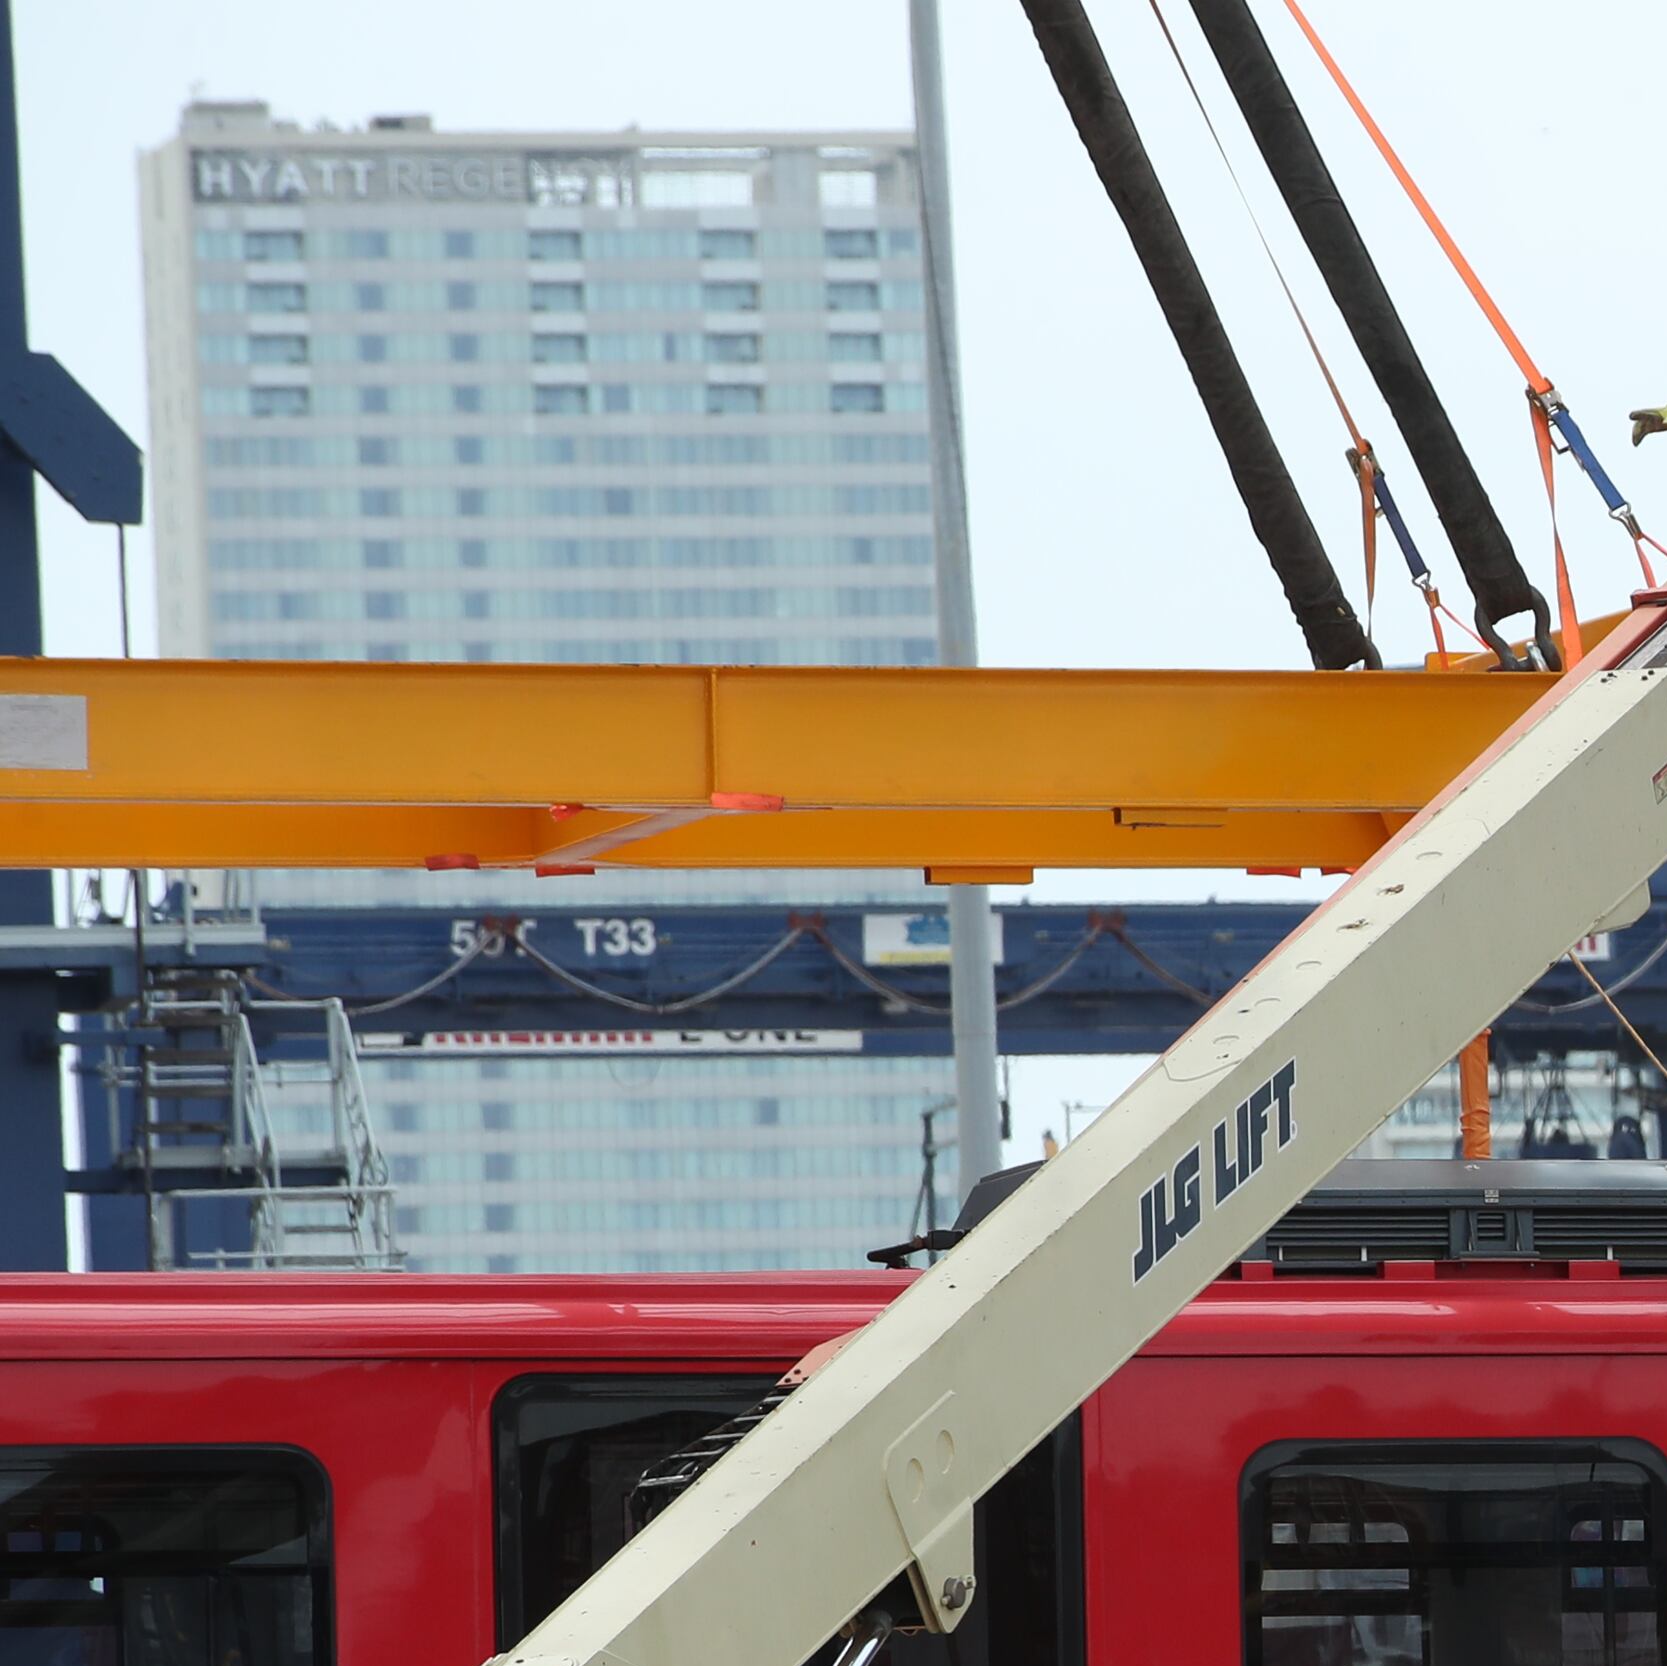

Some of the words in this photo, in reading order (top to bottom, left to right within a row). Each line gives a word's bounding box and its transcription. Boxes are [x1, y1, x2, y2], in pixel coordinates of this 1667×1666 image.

[201, 158, 377, 196] HYATT
[573, 918, 657, 957] T33
[1132, 1140, 1201, 1287] JLG
[1212, 1056, 1297, 1209] LIFT
